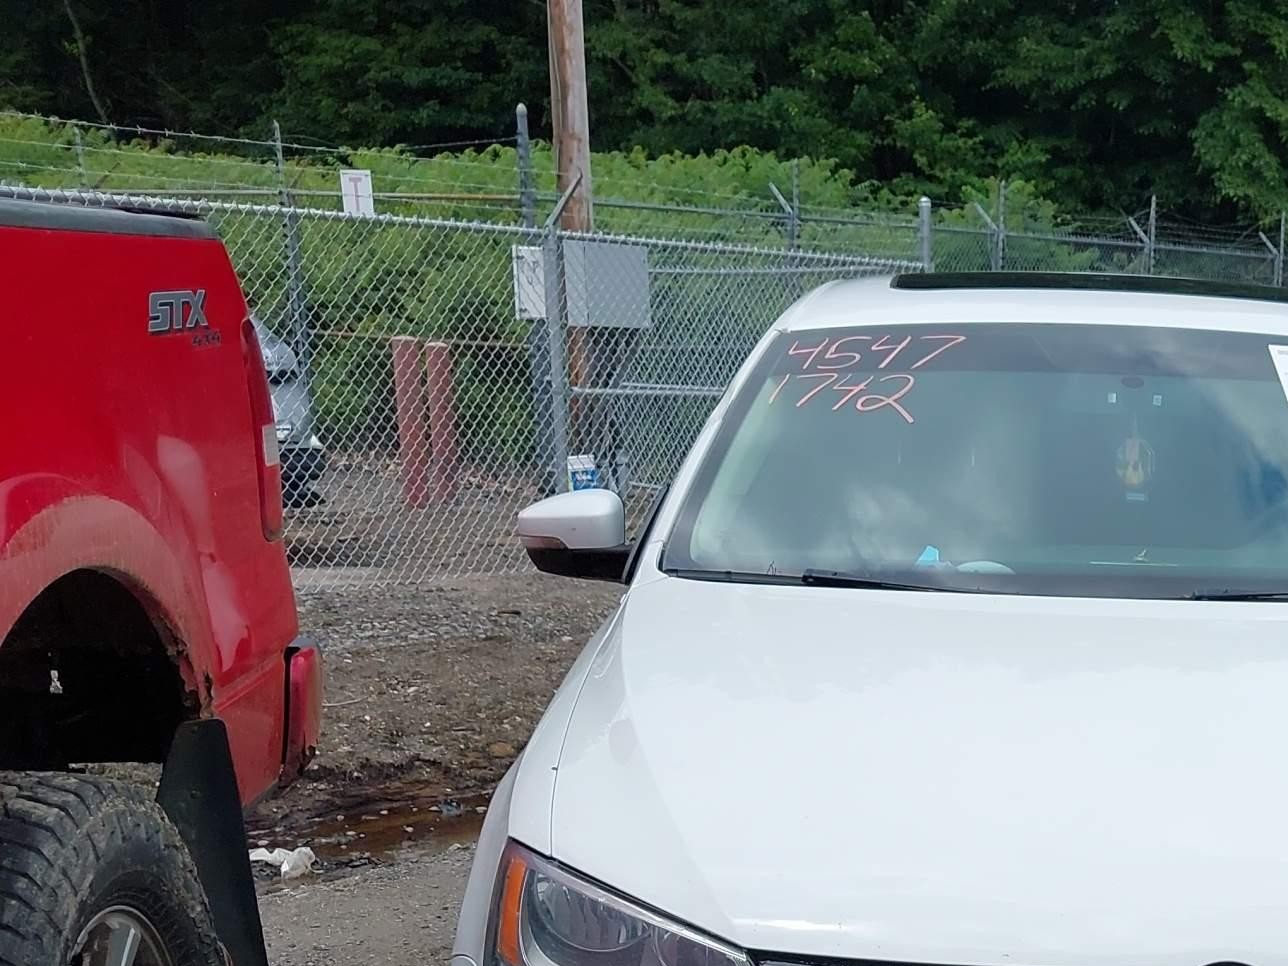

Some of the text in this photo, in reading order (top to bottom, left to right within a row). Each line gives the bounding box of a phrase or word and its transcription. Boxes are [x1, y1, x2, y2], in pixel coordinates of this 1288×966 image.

[148, 289, 208, 332] STX
[788, 334, 968, 370] 4547
[768, 372, 915, 424] 1742
